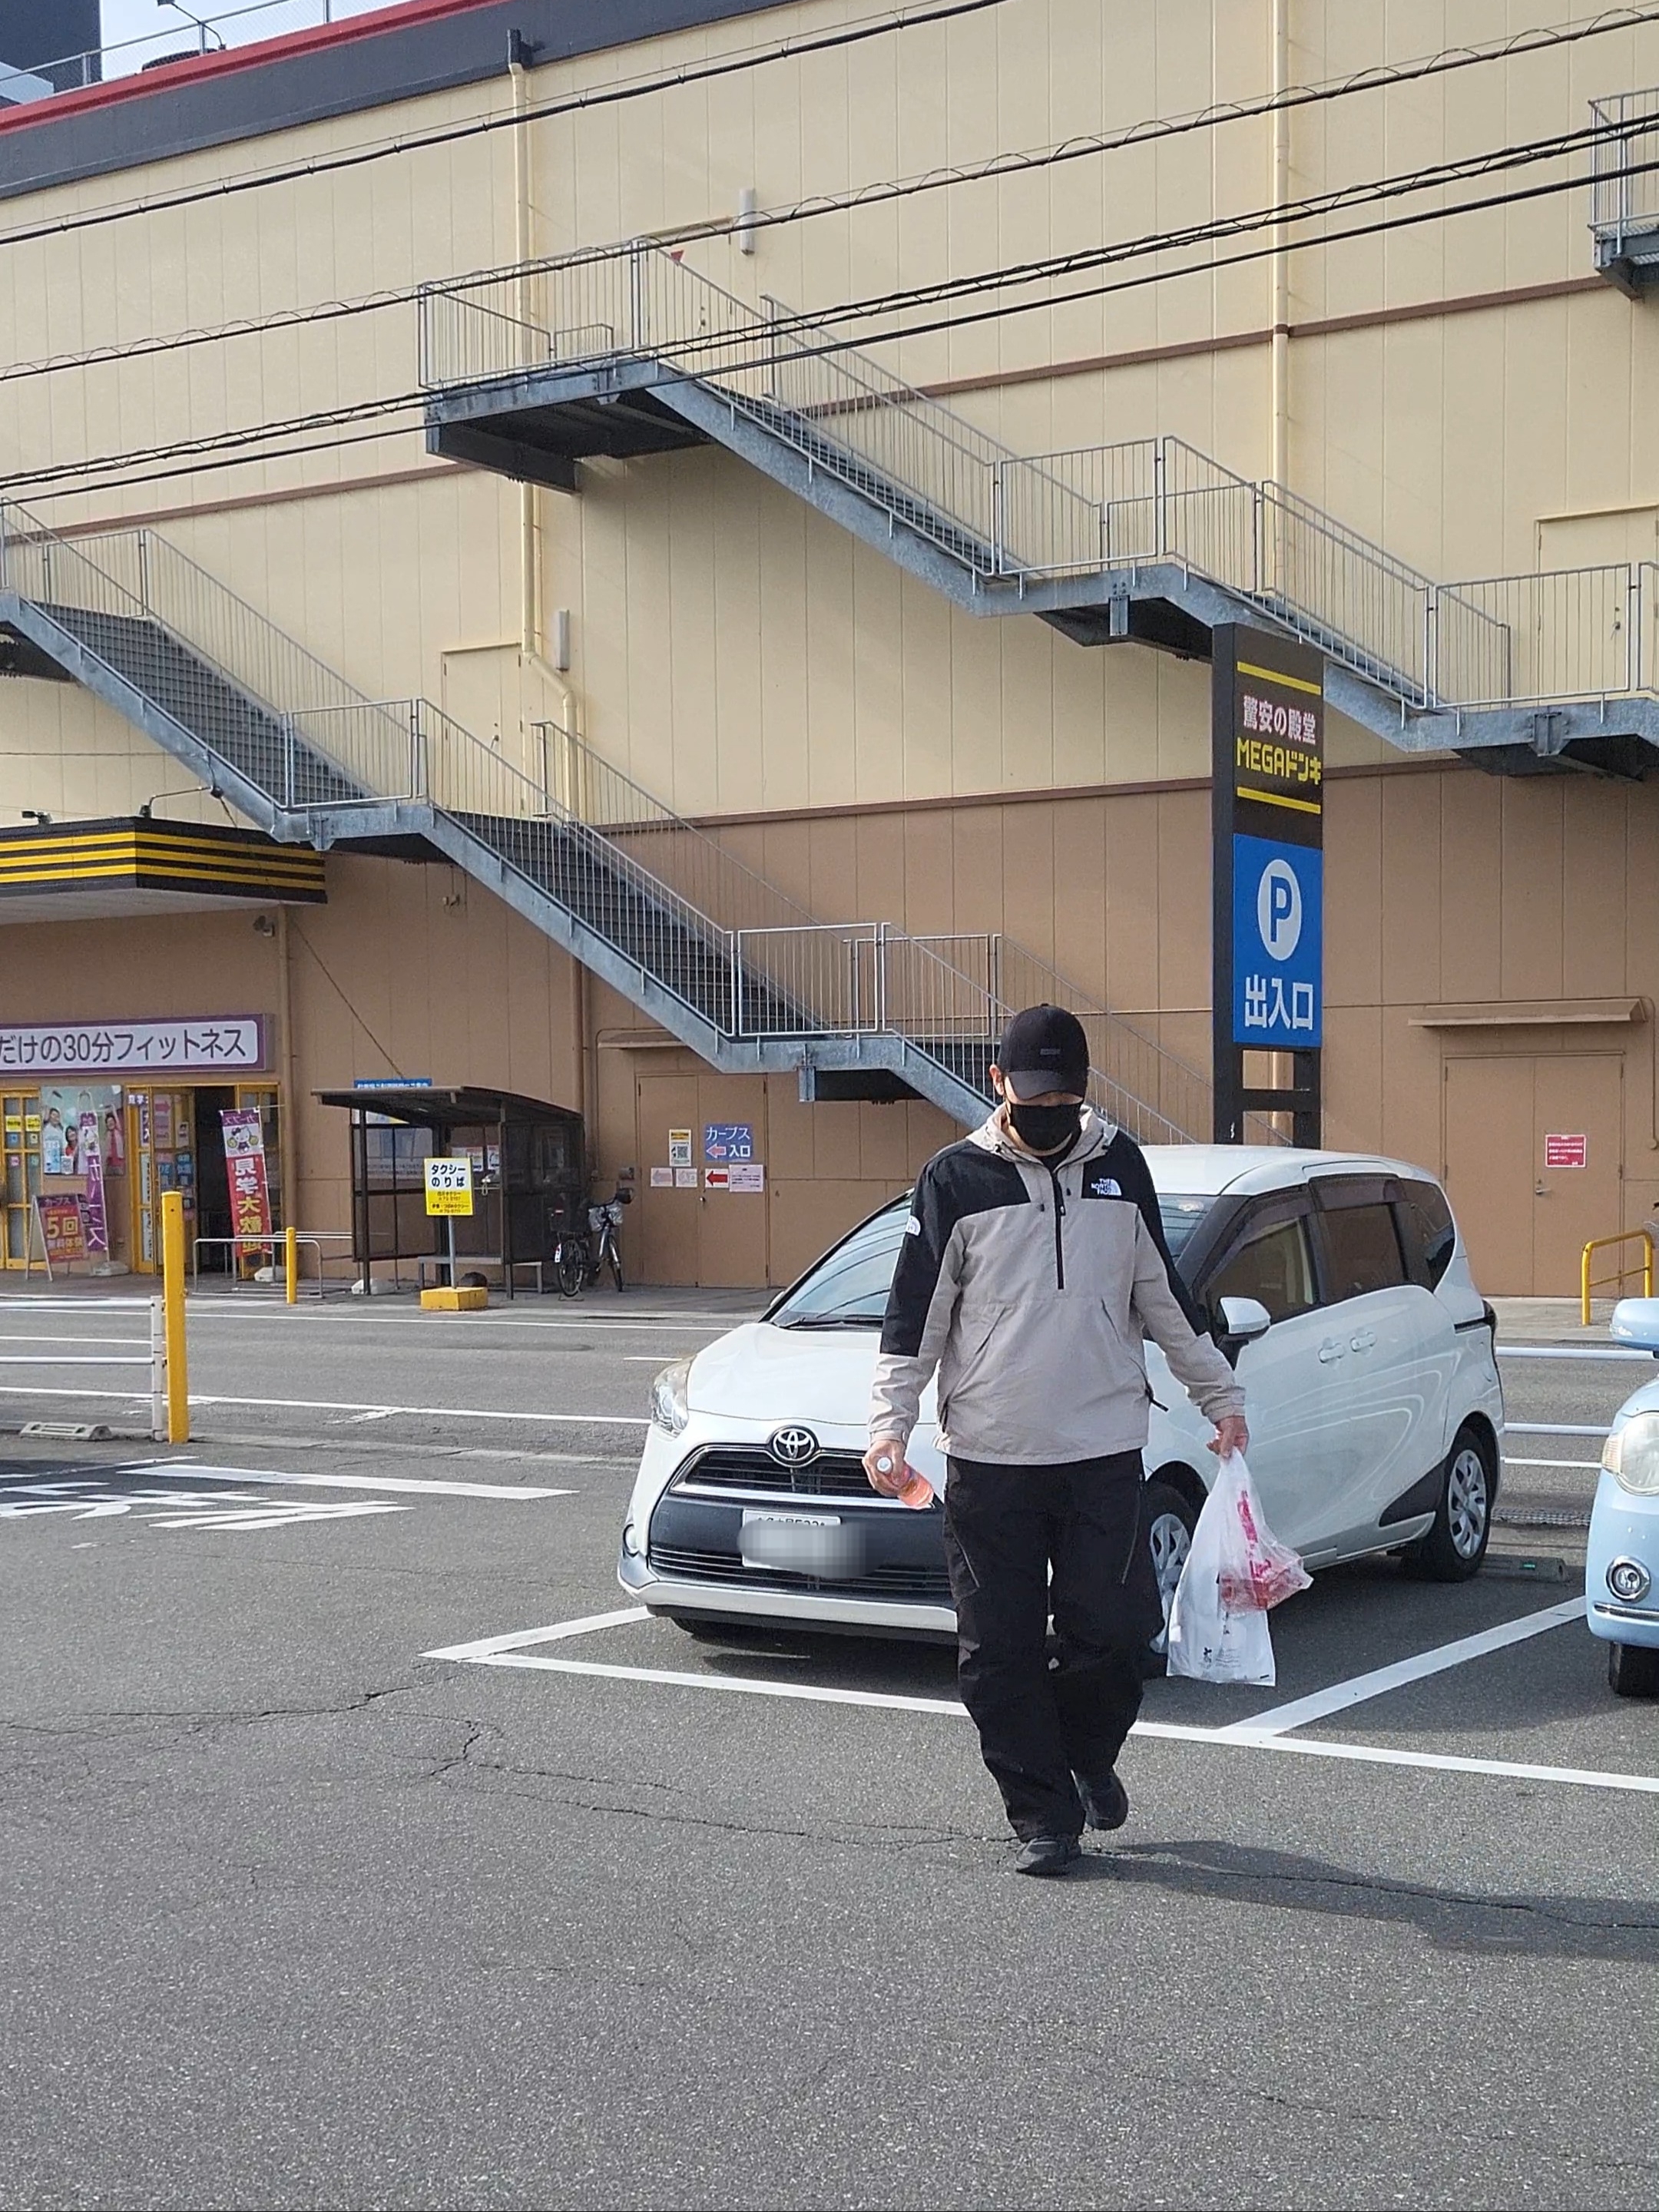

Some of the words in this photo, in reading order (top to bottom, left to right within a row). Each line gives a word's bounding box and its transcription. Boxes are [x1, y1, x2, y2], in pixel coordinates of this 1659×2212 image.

[1243, 694, 1316, 745] 驚安の殿堂
[1237, 737, 1322, 785] MEGAドンキ
[1270, 875, 1293, 943] P
[1244, 974, 1314, 1030] 出入口
[0, 1028, 247, 1064] だけの30分フィットネス
[706, 1126, 750, 1141] カーブス
[729, 1144, 750, 1157] 入口
[431, 1164, 465, 1174] タクシー
[431, 1177, 465, 1187] のりば
[46, 1216, 79, 1239] 5回
